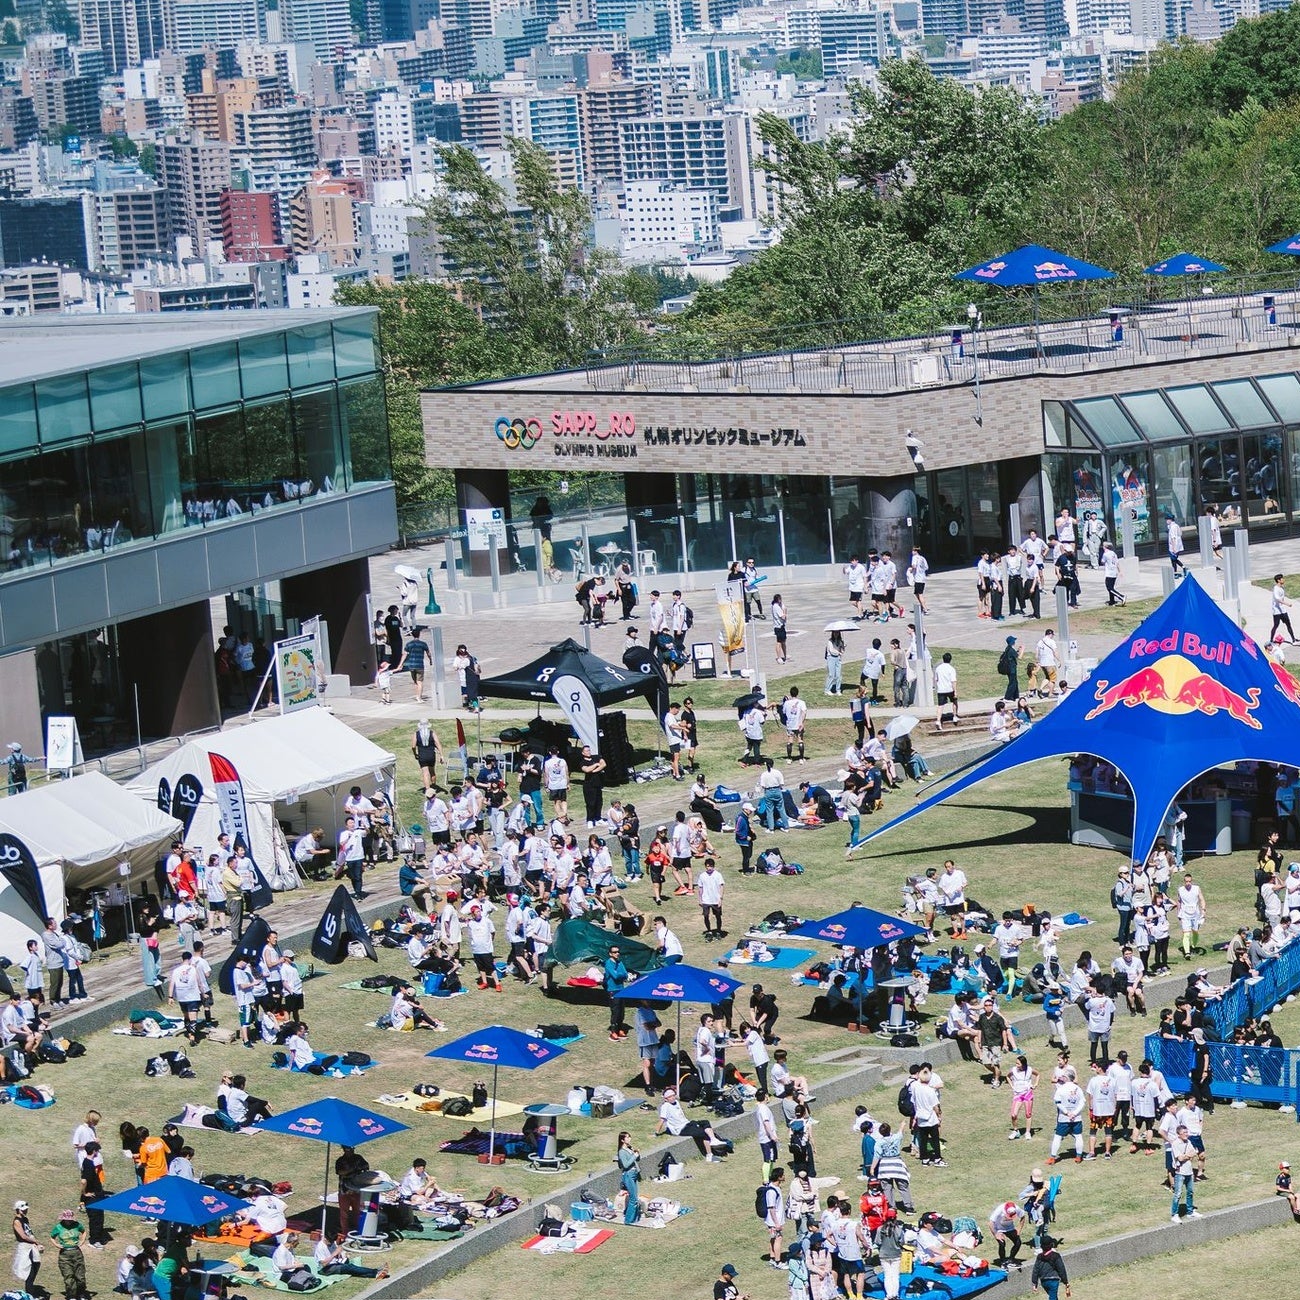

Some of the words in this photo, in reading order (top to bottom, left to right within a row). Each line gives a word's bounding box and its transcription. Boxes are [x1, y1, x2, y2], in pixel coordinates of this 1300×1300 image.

[644, 426, 807, 447] 札幌オリンピックミュージアム
[554, 443, 595, 457] OLYMPIC
[597, 443, 638, 458] MUSEUM
[1130, 629, 1179, 659] Red
[1182, 632, 1233, 666] Bull
